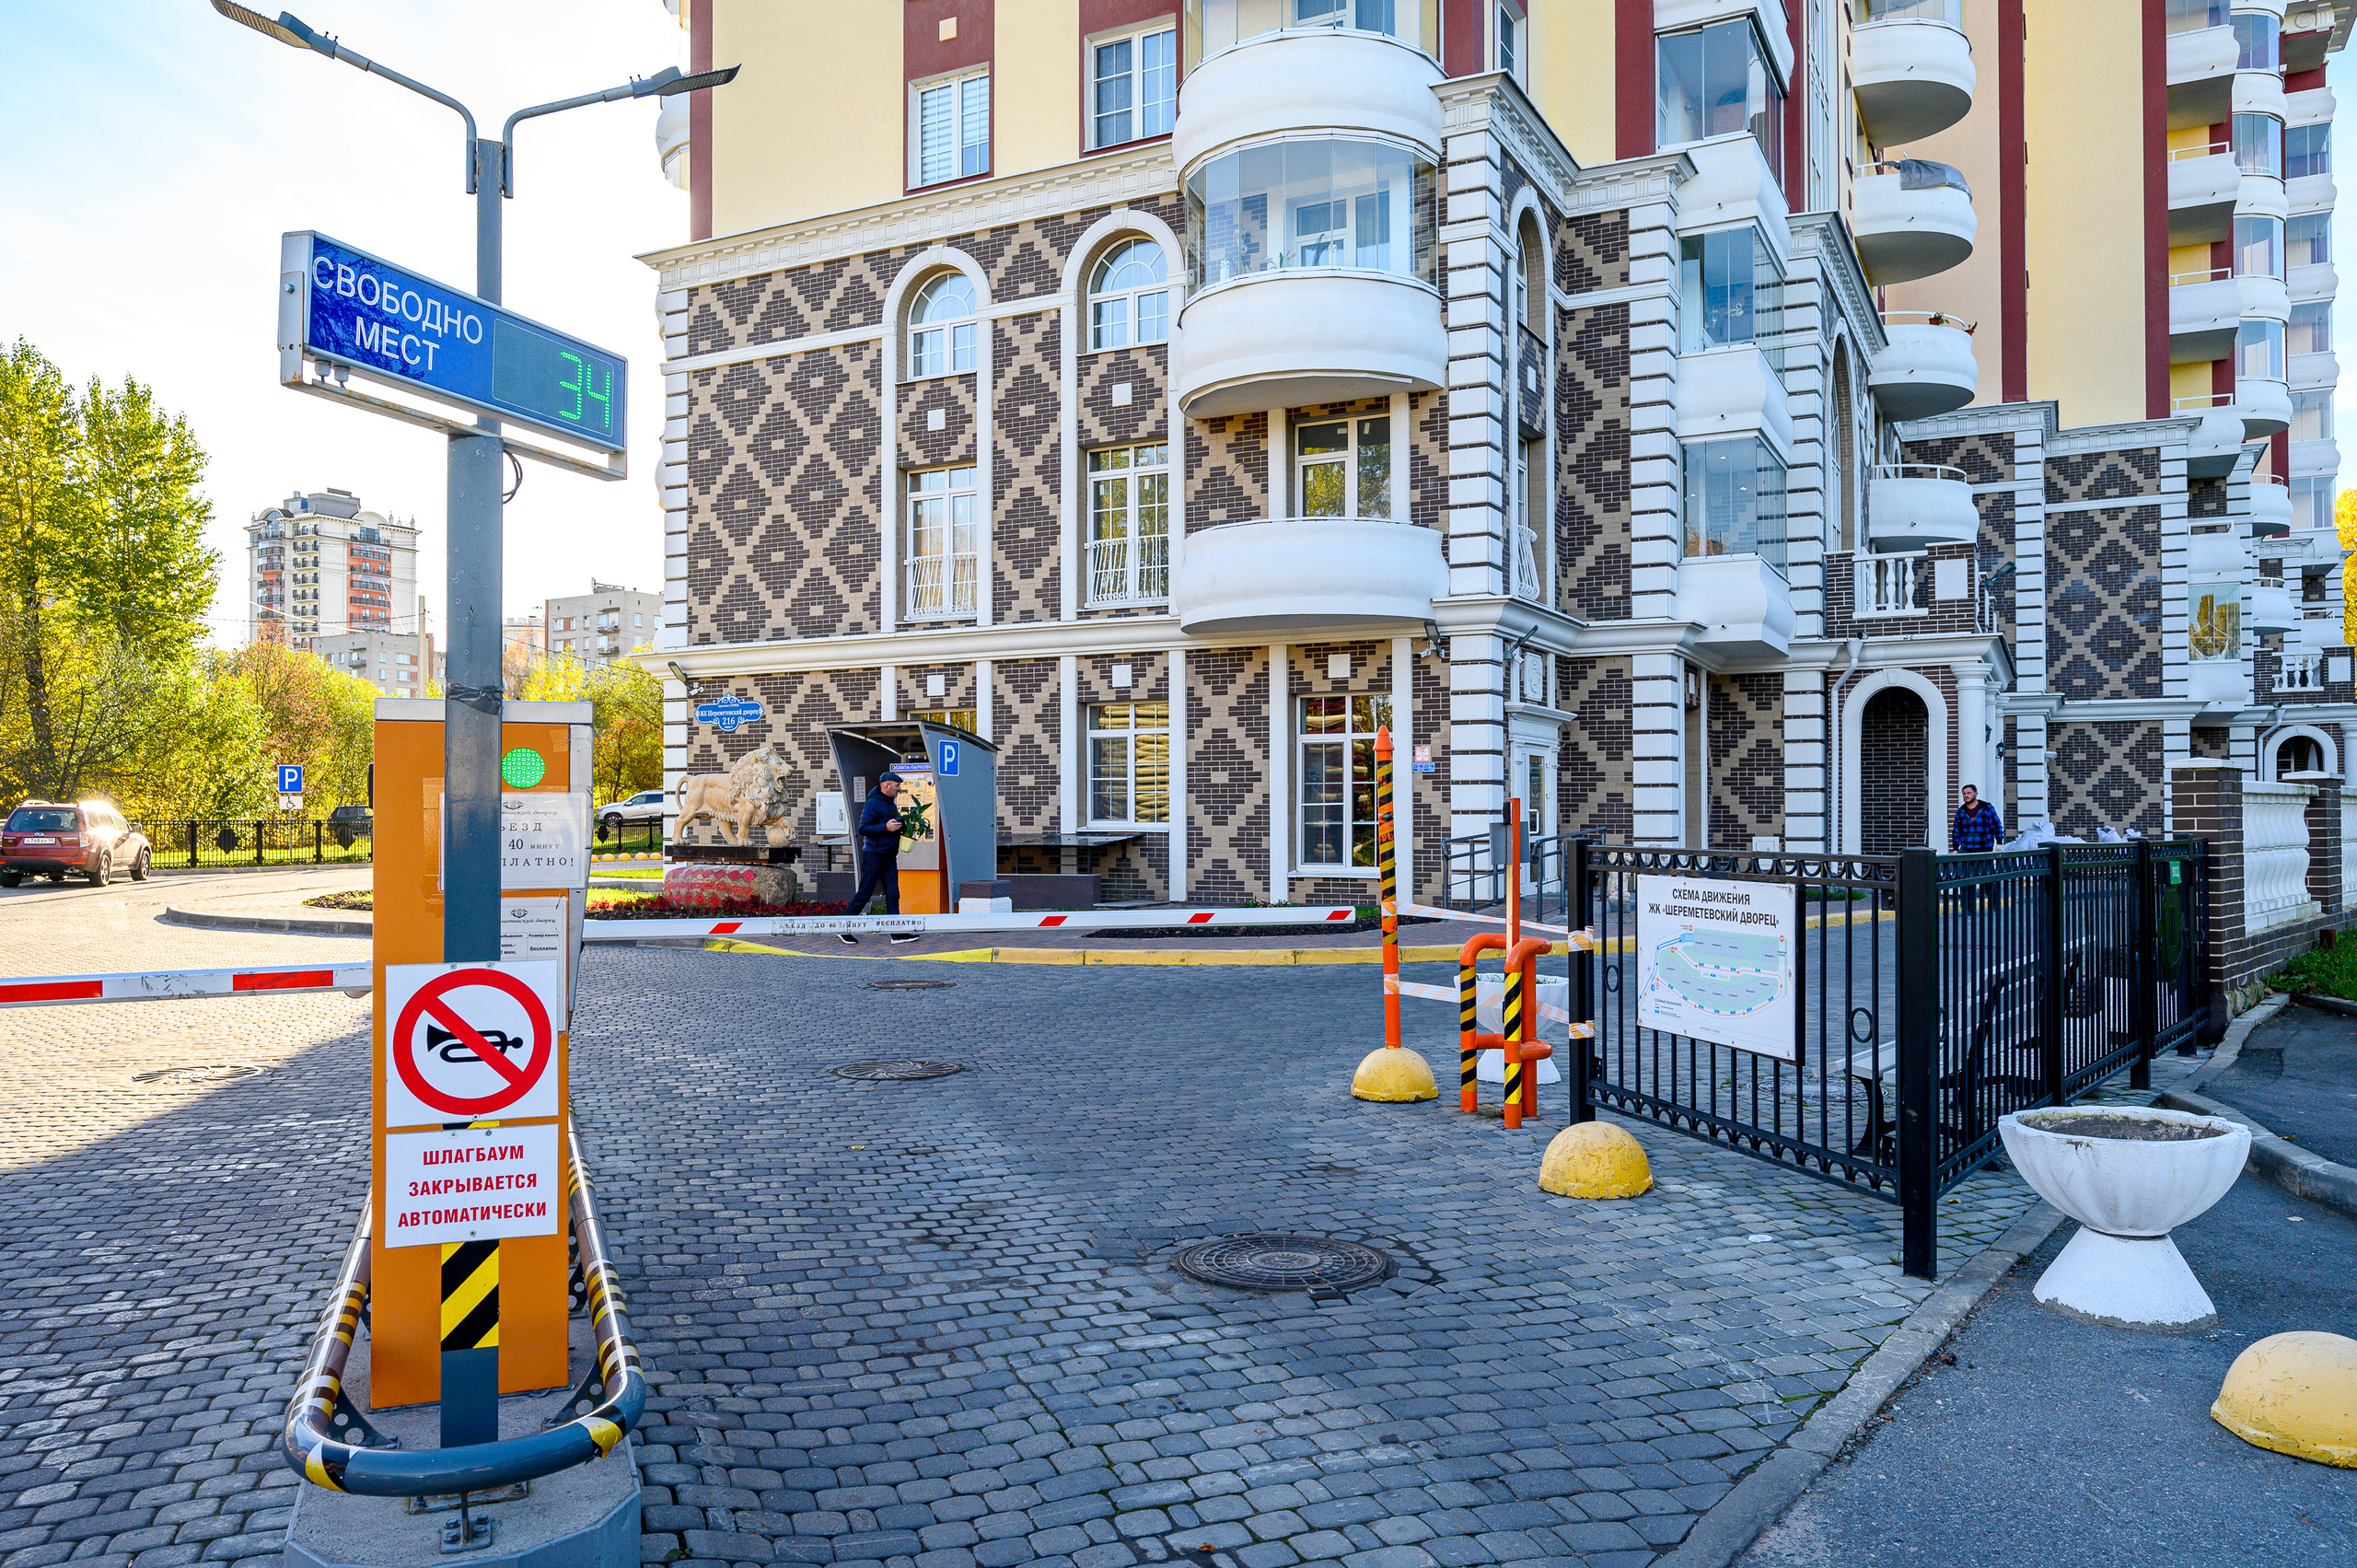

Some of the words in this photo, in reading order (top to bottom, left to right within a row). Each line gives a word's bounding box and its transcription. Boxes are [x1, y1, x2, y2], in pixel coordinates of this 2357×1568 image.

[311, 256, 483, 344] СВОБОДНО
[354, 315, 440, 371] МЕСТ
[558, 352, 610, 429] 34
[708, 709, 742, 717] Шереметевский
[944, 745, 956, 772] P
[284, 768, 298, 790] P
[508, 838, 524, 850] 40
[1672, 888, 1701, 901] СХЕМА
[1701, 890, 1750, 906] ДВИЖЕНИЯ
[1648, 902, 1661, 914] ЖК
[1739, 912, 1780, 929] ДВОРЕЦ»
[423, 1144, 524, 1166] ШЛАГБАУМ
[408, 1173, 538, 1196] ЗАКРЫВАЕТСЯ
[398, 1202, 547, 1227] АВТОМАТИЧЕСКИ
